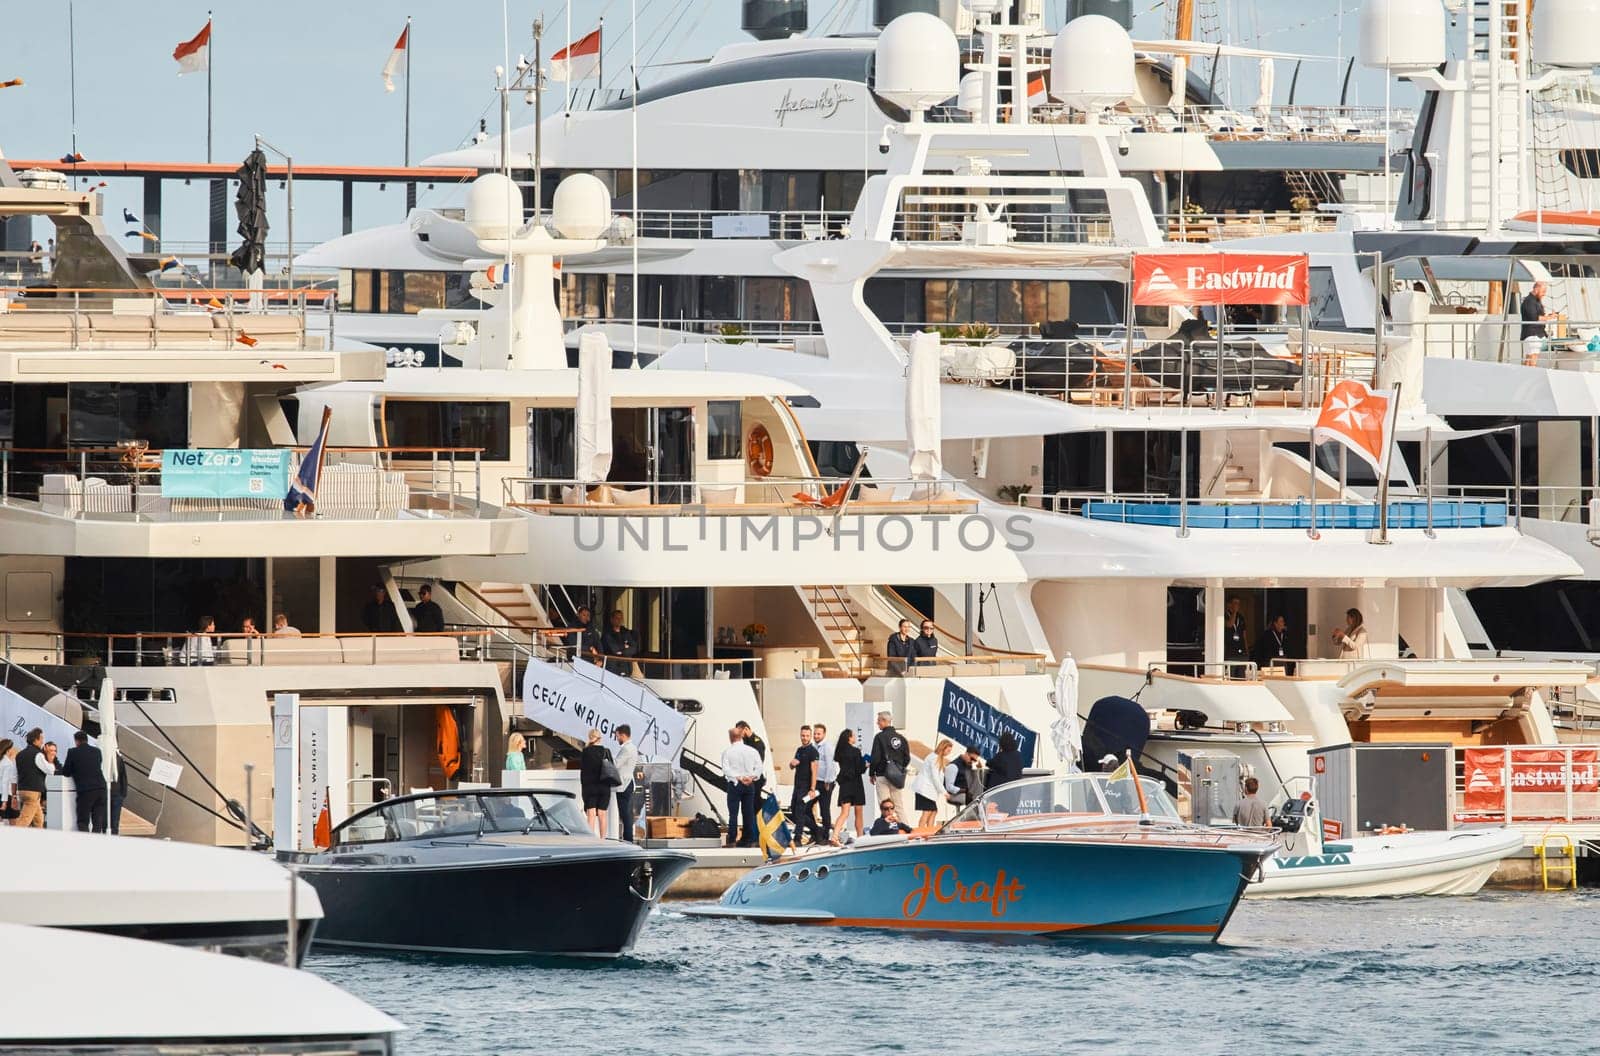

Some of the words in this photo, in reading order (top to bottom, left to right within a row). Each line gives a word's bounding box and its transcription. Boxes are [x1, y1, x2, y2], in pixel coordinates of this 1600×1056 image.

[1186, 264, 1296, 290] Eastwind
[172, 451, 242, 466] NetZero
[532, 683, 567, 713] CECIL
[574, 701, 617, 741] WRIGH
[949, 691, 987, 729] ROYAL
[902, 863, 1025, 918] JCraft
